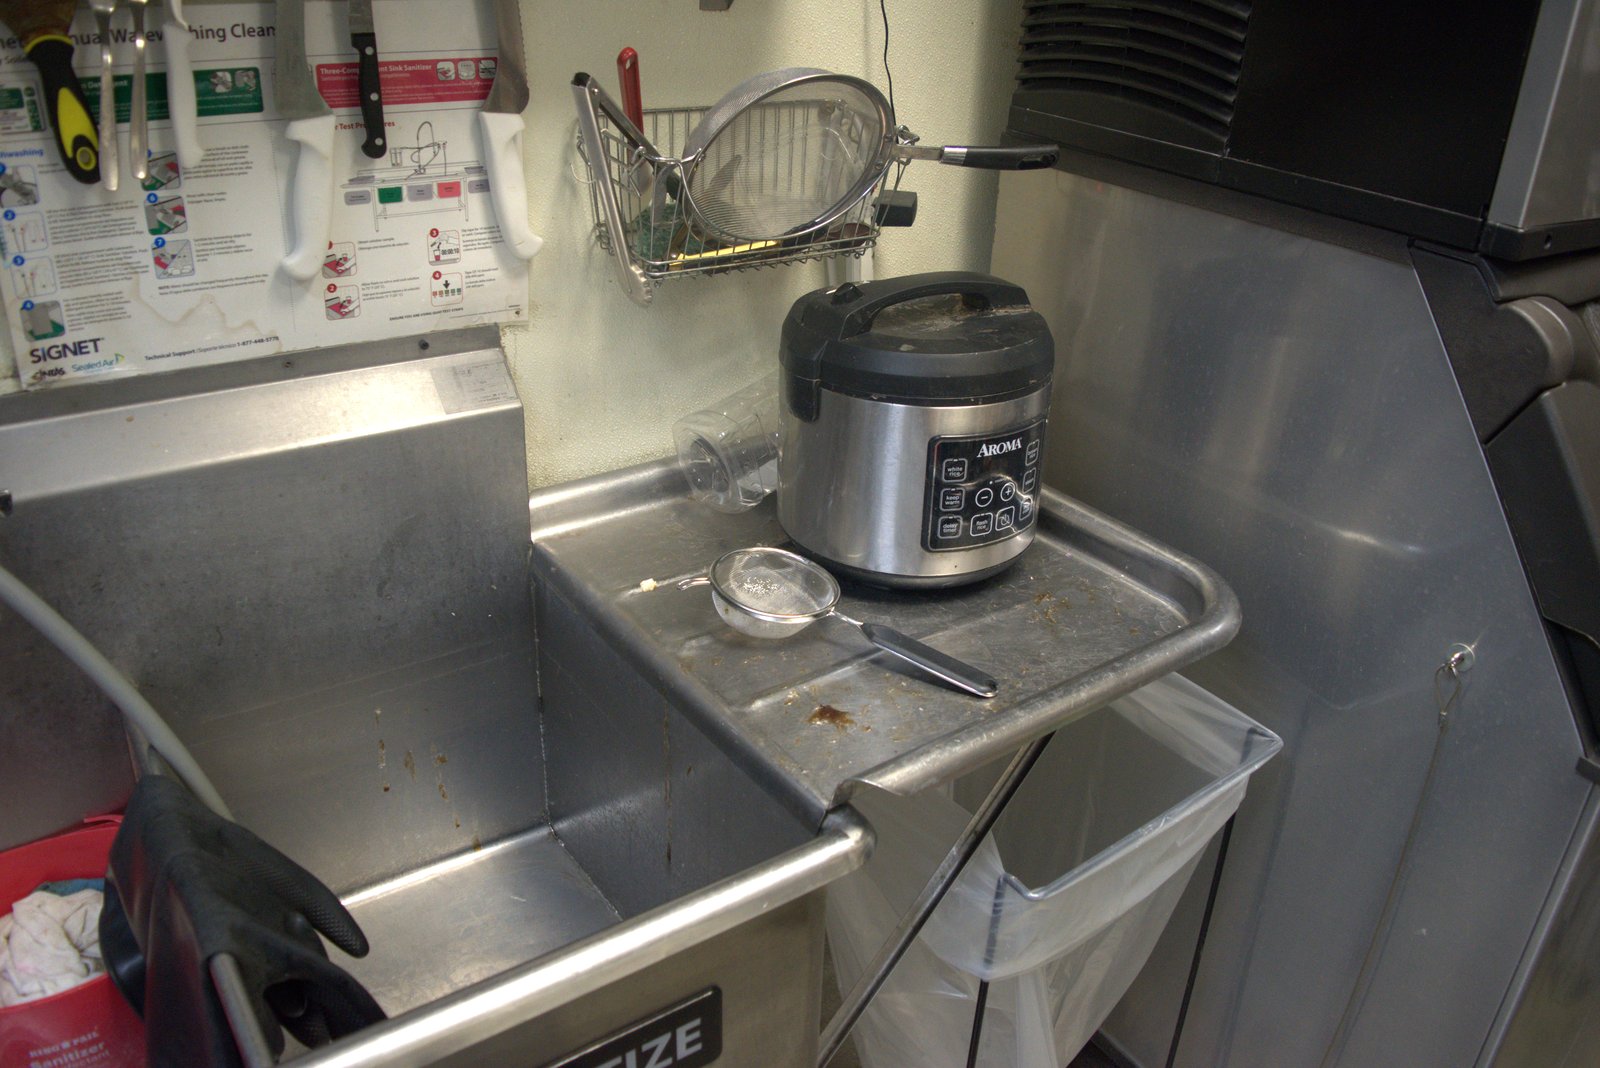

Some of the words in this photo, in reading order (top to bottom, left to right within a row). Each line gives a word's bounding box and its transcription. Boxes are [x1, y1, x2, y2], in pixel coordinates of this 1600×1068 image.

[110, 24, 227, 44] Waewhing
[231, 23, 276, 40] Clean
[404, 64, 432, 72] Sanitizer
[30, 338, 101, 364] SIGNET
[145, 352, 171, 361] Technical
[172, 349, 196, 358] Support
[976, 438, 1022, 458] AROMA
[594, 1017, 704, 1068] IZE
